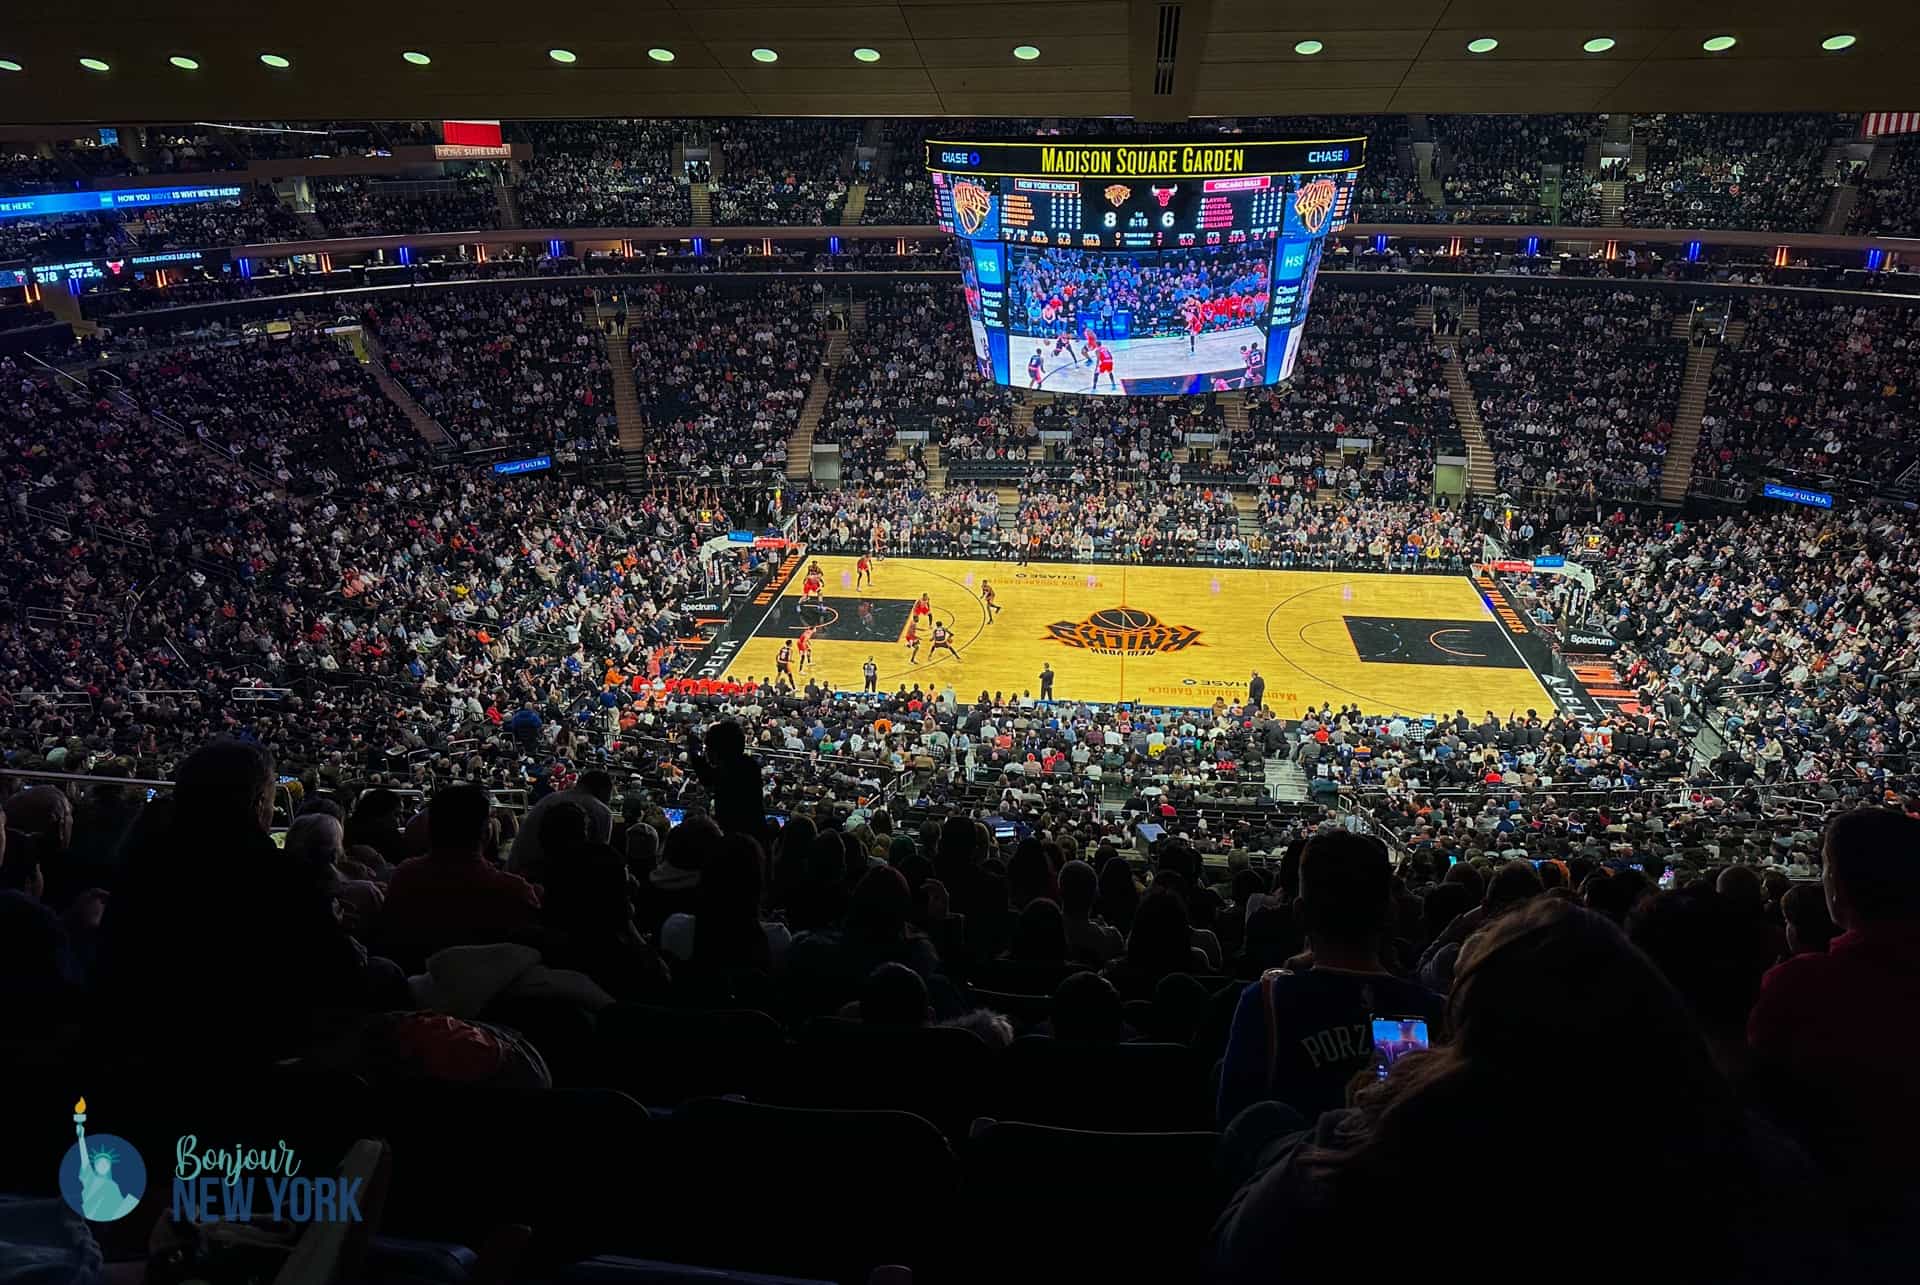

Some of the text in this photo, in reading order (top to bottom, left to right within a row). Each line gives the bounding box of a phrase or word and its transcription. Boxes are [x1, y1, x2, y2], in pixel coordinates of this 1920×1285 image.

[464, 148, 485, 156] SUITE
[487, 147, 508, 155] LEVEL
[1308, 150, 1343, 162] CHASE
[942, 152, 968, 164] CHASE
[1042, 147, 1244, 173] MADISON SQUARE GARDEN
[1018, 181, 1075, 191] NEW YORK KNICKS
[136, 194, 150, 202] YOU
[1104, 212, 1116, 227] 8
[1162, 212, 1175, 227] 6
[36, 272, 58, 283] 3/8
[525, 460, 546, 469] ULTRA
[1800, 493, 1826, 504] ULTRA
[680, 602, 718, 612] Spectrum
[1046, 620, 1207, 651] KNICKS
[1570, 634, 1613, 646] Spectrum
[699, 639, 740, 676] DELTA
